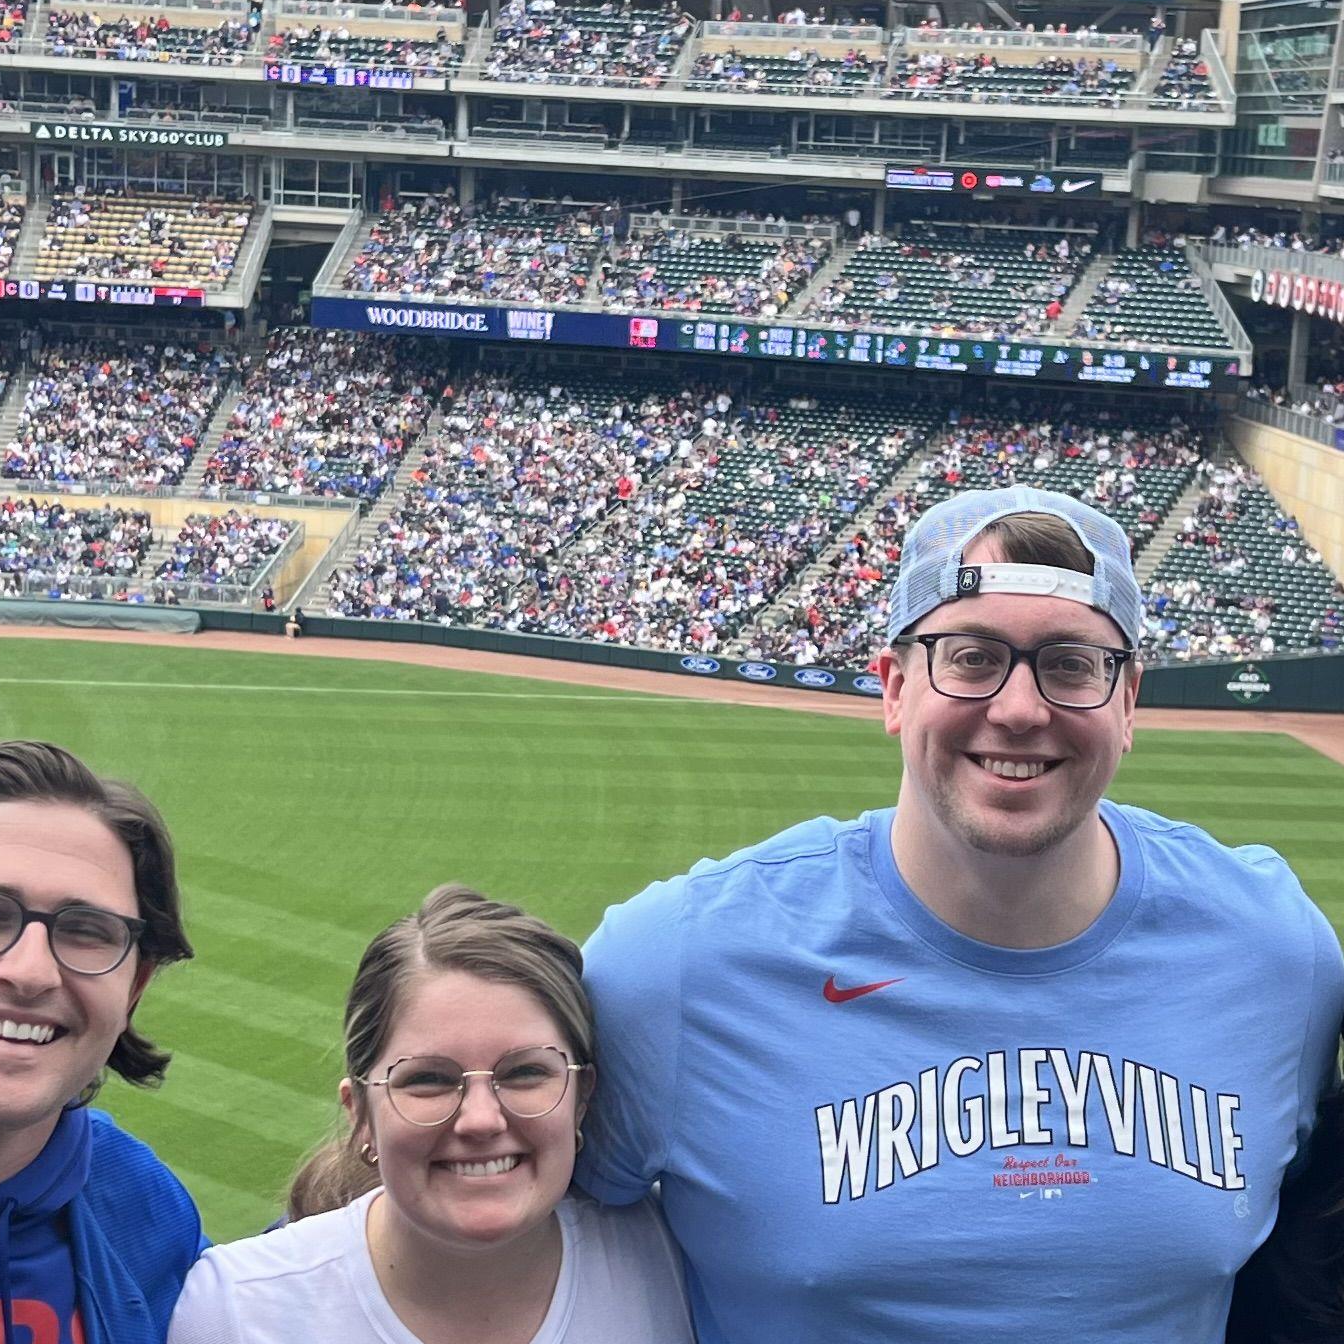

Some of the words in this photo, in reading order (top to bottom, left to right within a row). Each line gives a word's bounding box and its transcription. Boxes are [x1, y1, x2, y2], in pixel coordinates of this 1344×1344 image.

[55, 126, 113, 141] DELTA
[815, 1048, 1246, 1204] WRIGLEYVILLE
[1002, 1155, 1049, 1170] Respect
[1054, 1153, 1078, 1169] Our
[993, 1171, 1091, 1188] NEIGHBORHOOD
